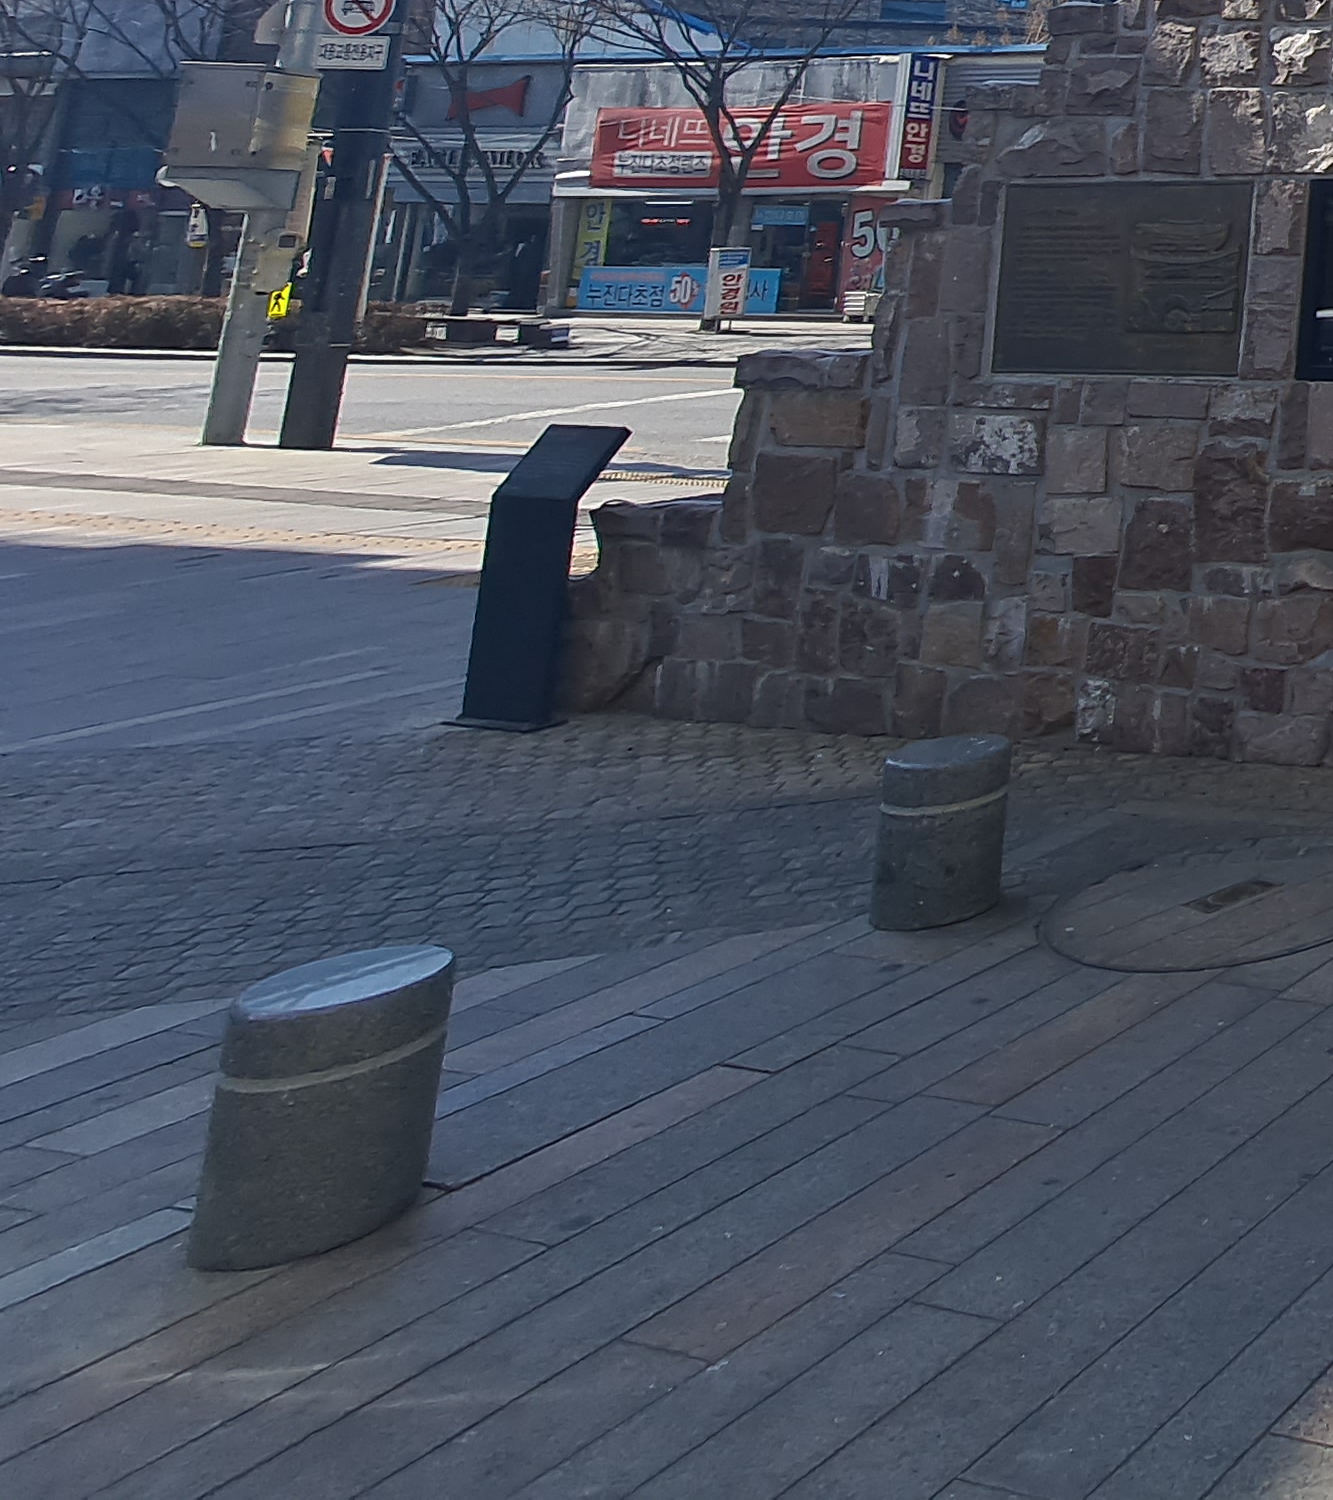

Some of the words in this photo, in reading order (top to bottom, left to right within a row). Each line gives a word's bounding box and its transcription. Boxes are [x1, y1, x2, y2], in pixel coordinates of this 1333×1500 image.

[723, 110, 864, 180] 안경
[904, 122, 929, 163] 안경
[586, 284, 664, 308] 누진다초점
